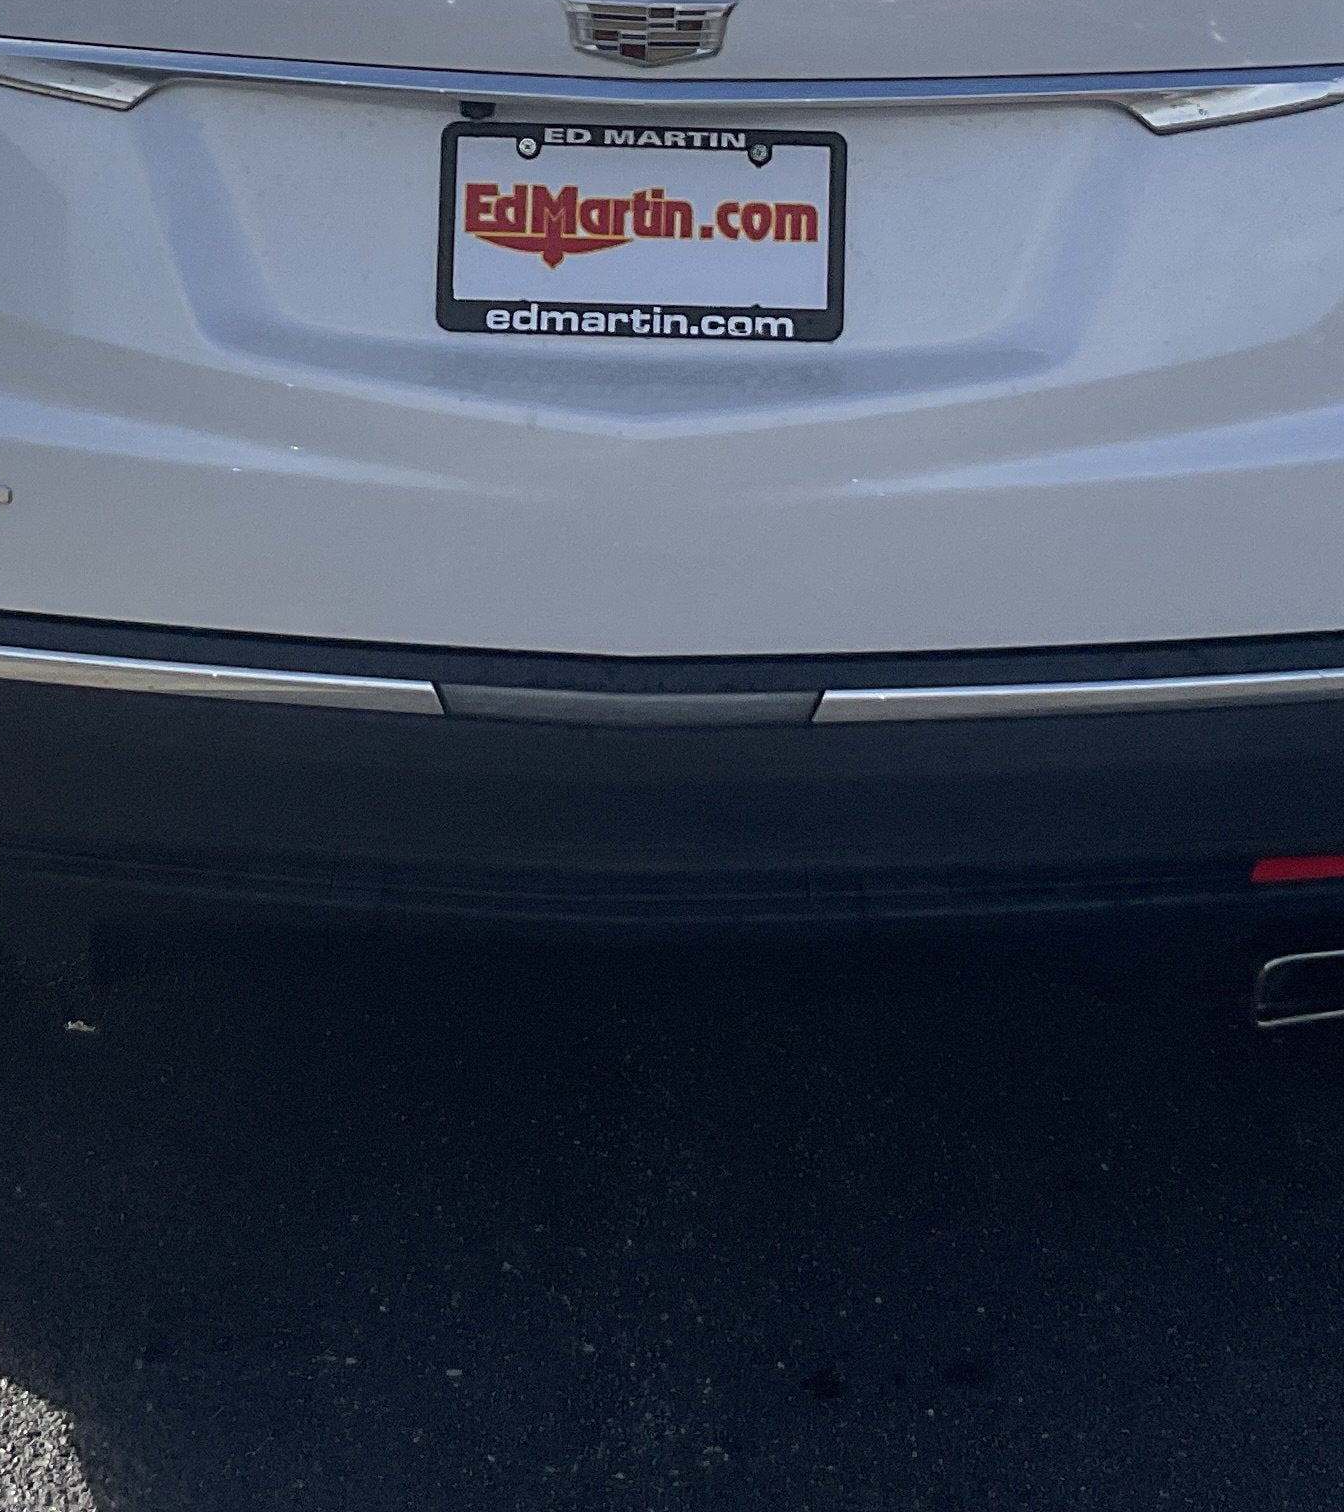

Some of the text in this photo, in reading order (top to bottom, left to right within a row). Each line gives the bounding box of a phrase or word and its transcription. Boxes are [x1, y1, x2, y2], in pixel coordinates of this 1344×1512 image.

[544, 128, 747, 149] ED MARTIN
[464, 182, 820, 246] EdMartin.com
[485, 303, 795, 338] edmartin.com
